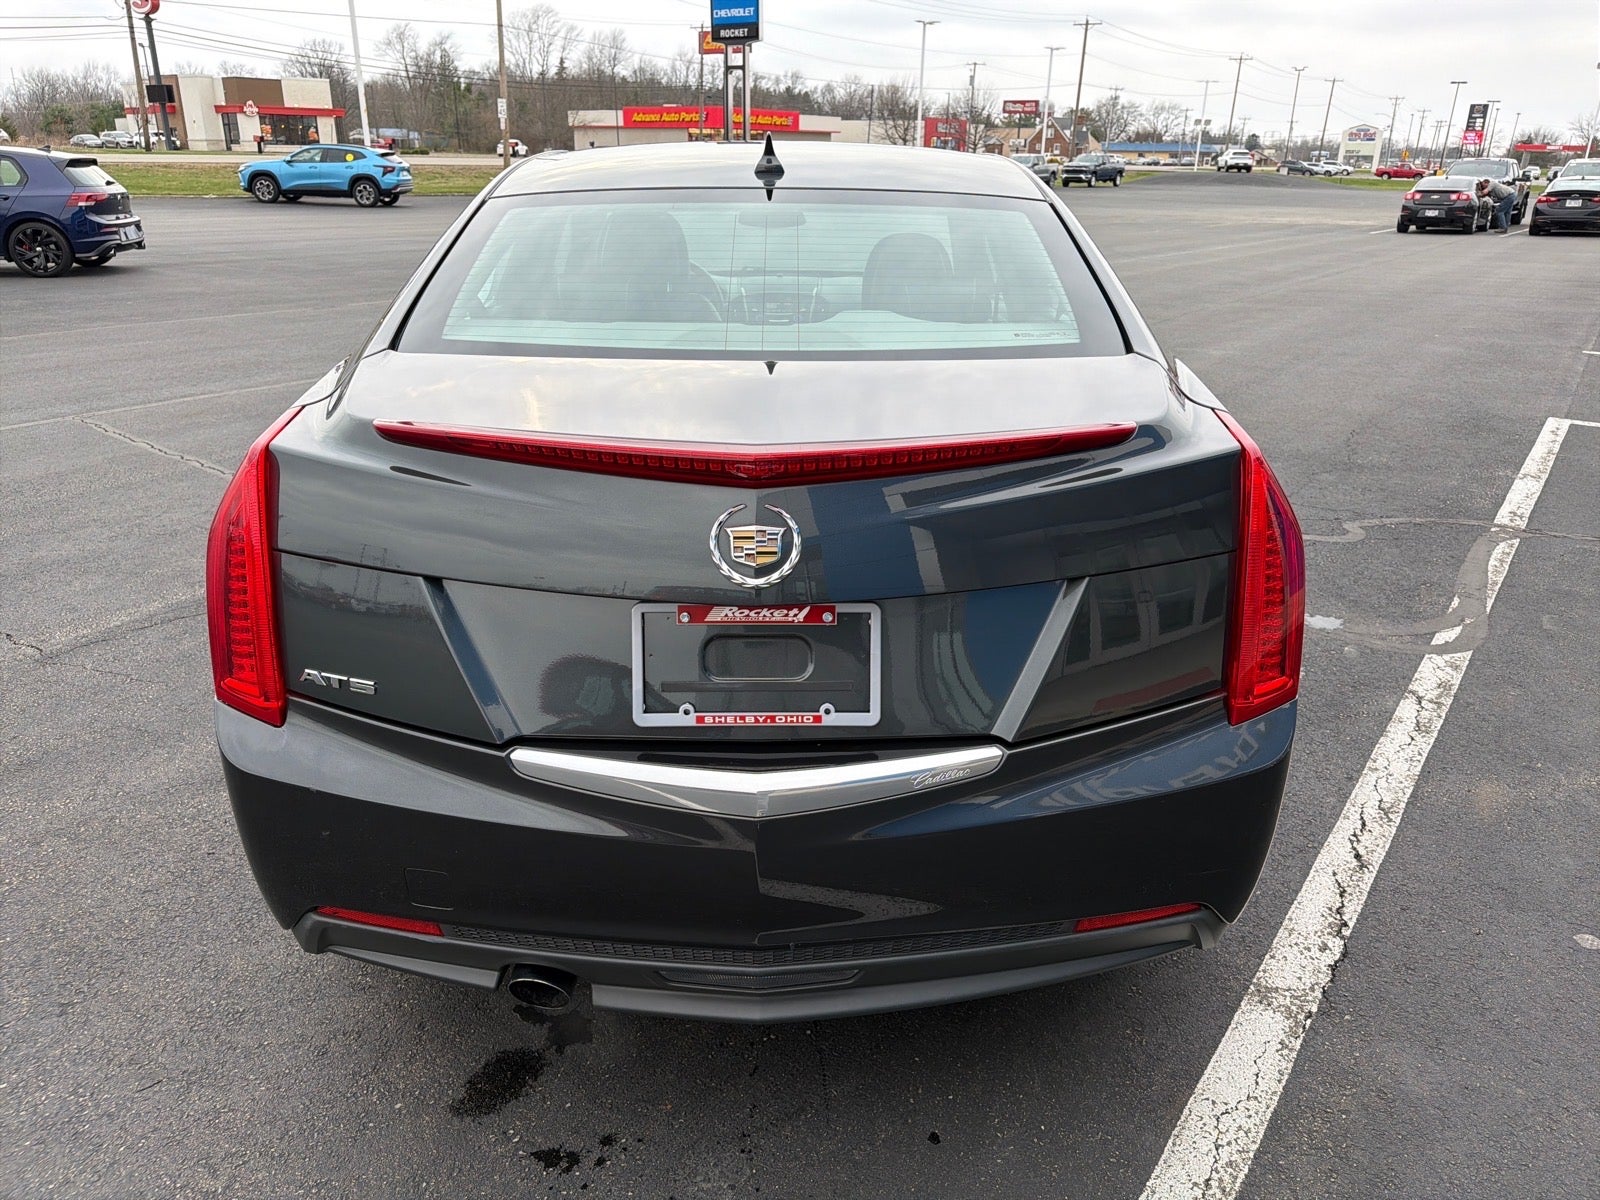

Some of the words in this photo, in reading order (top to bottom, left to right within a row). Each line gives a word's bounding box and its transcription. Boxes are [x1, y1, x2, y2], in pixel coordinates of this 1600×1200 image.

[713, 7, 755, 18] CHEVROLET
[720, 28, 749, 38] ROCKET
[632, 112, 660, 122] Advance
[661, 112, 680, 122] Auto
[679, 111, 701, 122] Parts
[756, 115, 772, 125] Auto
[771, 116, 789, 126] Parts
[298, 668, 377, 696] ATS
[775, 715, 814, 724] OHIO
[910, 768, 971, 789] Cadillac
